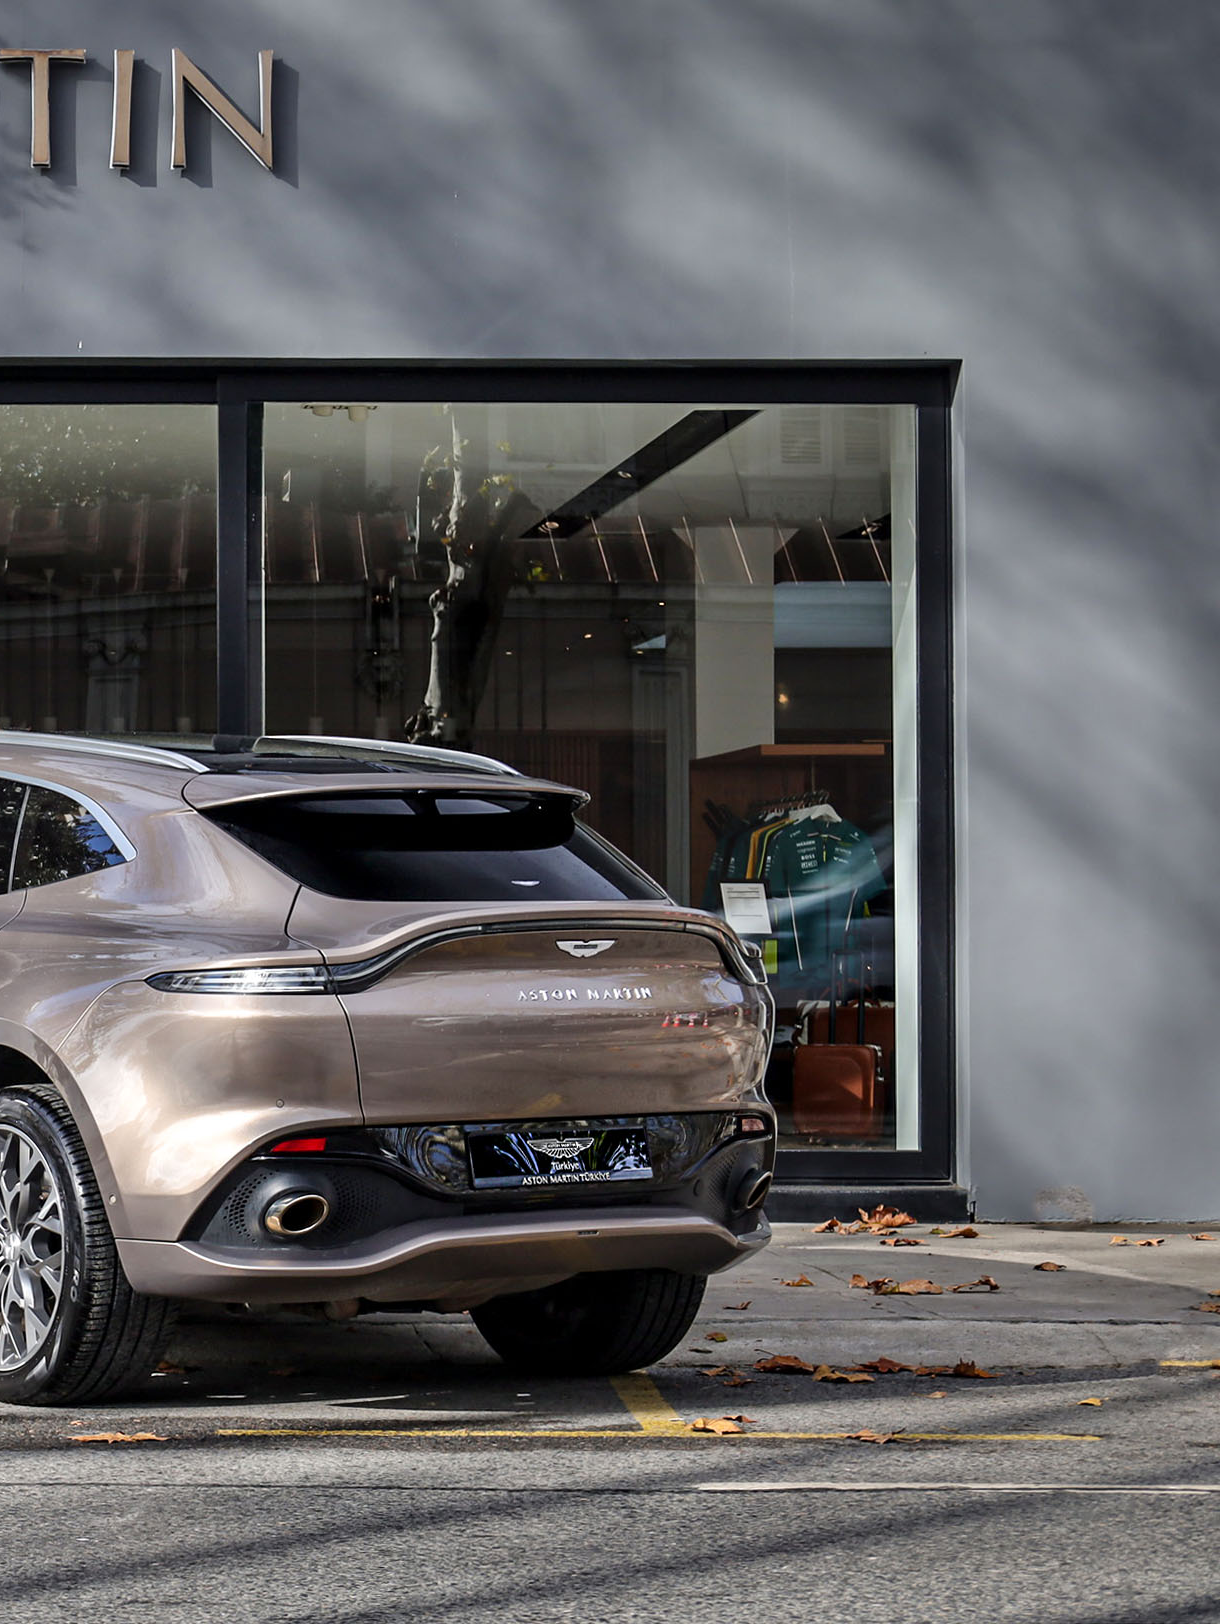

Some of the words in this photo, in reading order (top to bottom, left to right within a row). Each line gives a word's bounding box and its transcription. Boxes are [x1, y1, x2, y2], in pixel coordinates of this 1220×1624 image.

[517, 988, 578, 1001] ASTON
[587, 987, 653, 1000] MARTIN
[551, 1161, 580, 1172] Türkiye
[522, 1175, 548, 1185] ASTON
[550, 1174, 579, 1184] MARTIN
